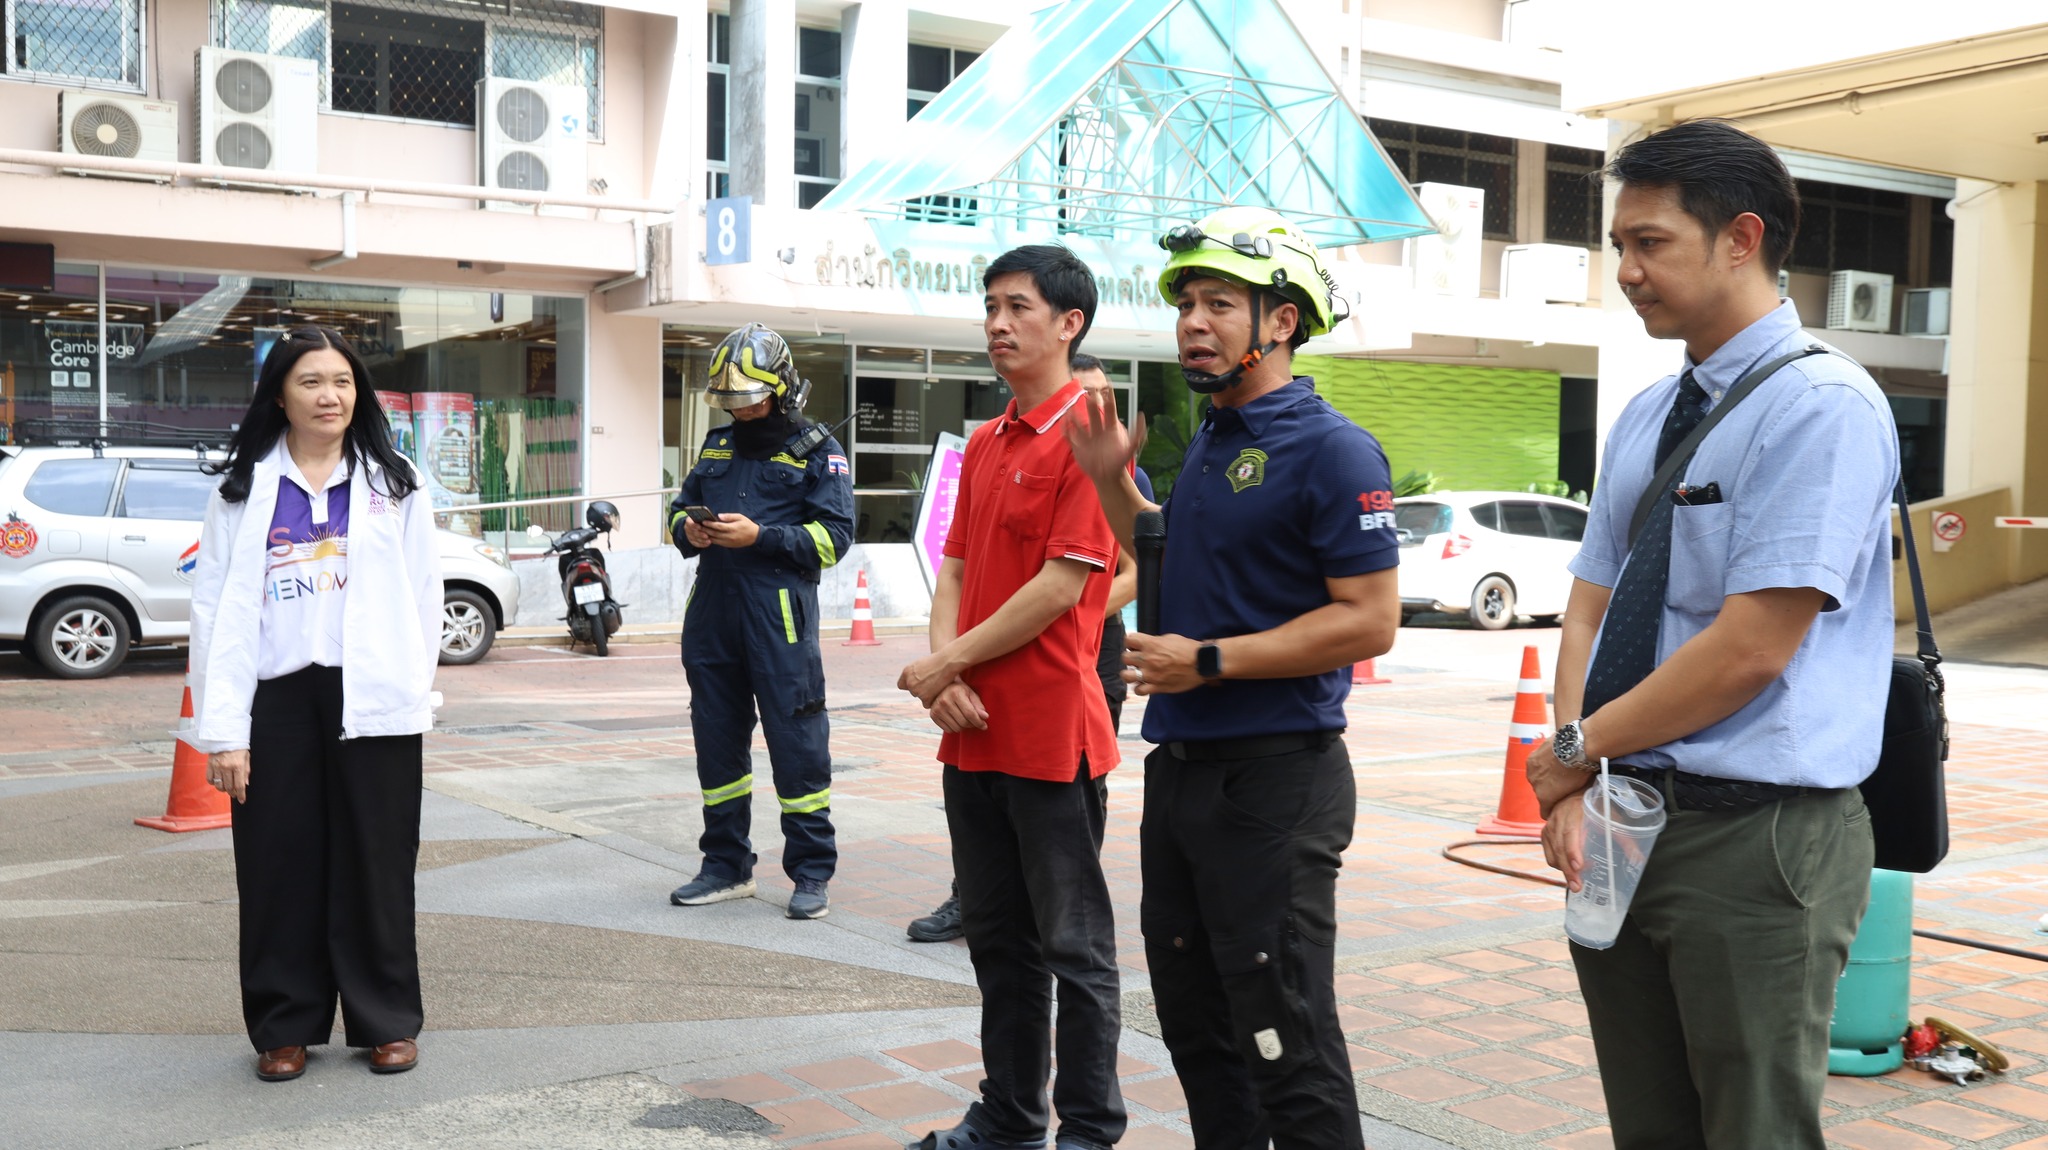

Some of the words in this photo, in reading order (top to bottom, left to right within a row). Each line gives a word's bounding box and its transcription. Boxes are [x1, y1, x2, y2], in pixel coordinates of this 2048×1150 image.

[717, 206, 736, 256] 8
[50, 353, 90, 367] Core
[269, 527, 294, 557] S
